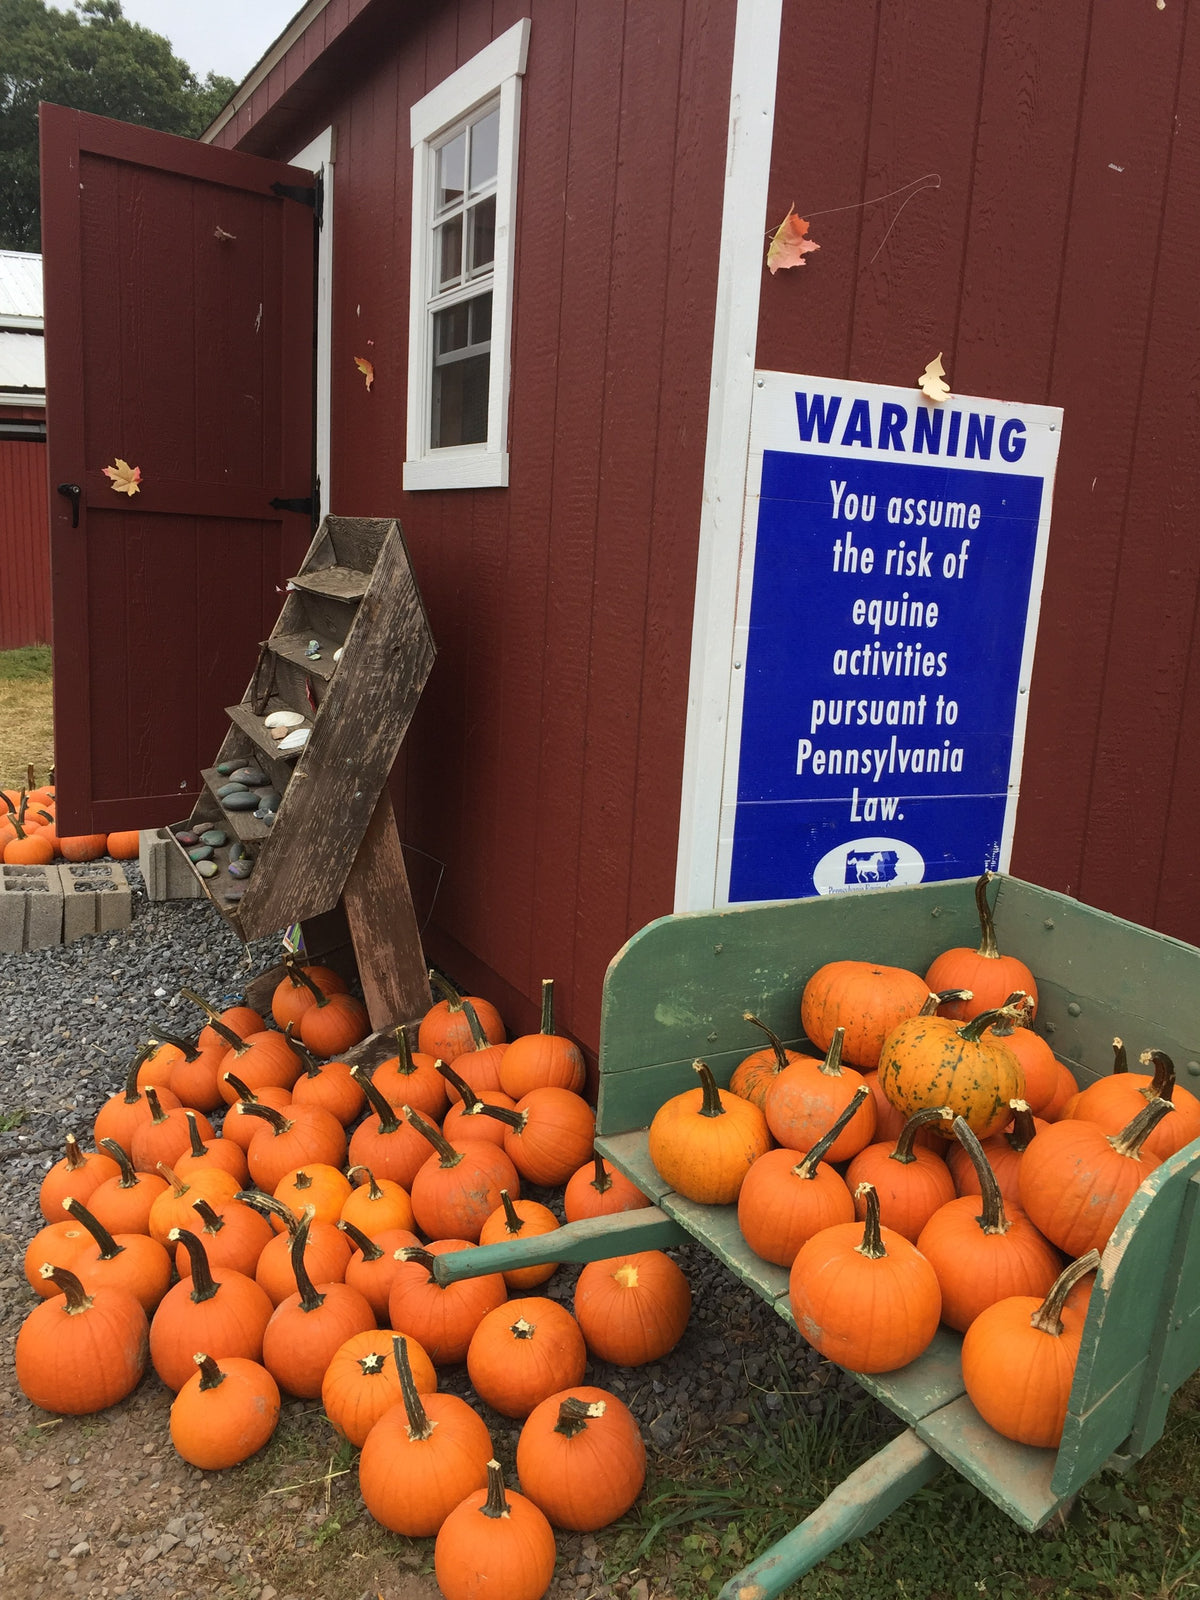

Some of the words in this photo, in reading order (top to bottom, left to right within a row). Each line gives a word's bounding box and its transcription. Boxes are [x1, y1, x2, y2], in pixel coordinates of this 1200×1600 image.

[794, 391, 1027, 463] WARNING
[830, 480, 875, 522] You
[887, 496, 981, 530] assume
[833, 532, 875, 574] the
[885, 537, 932, 578] risk
[942, 540, 970, 579] of
[852, 592, 939, 635] equine
[833, 641, 948, 677] activities
[810, 694, 927, 734] pursuant
[936, 695, 958, 726] to
[796, 735, 964, 782] Pennsylvania
[850, 787, 905, 823] Law.
